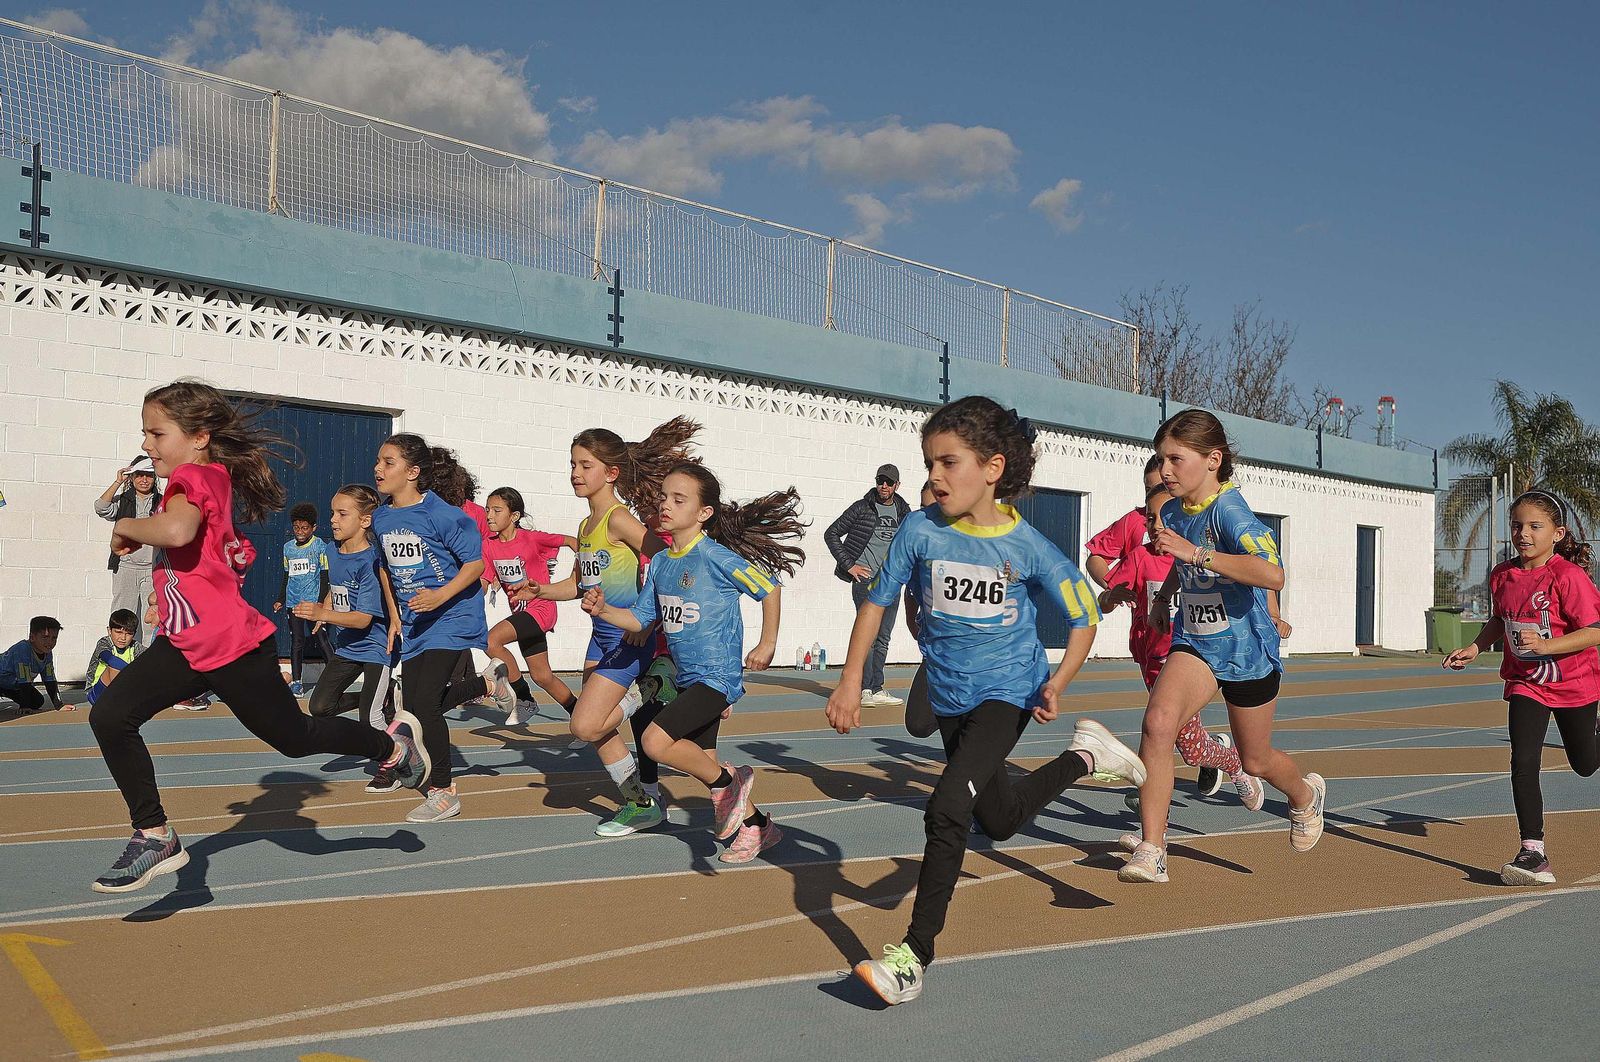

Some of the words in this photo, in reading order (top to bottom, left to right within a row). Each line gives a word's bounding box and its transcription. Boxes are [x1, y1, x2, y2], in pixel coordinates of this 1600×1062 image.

[391, 542, 422, 558] 3261
[293, 562, 310, 572] 3311
[498, 565, 521, 577] 3234
[943, 576, 1004, 605] 3246
[662, 604, 683, 624] 242
[1187, 603, 1228, 624] 3251
